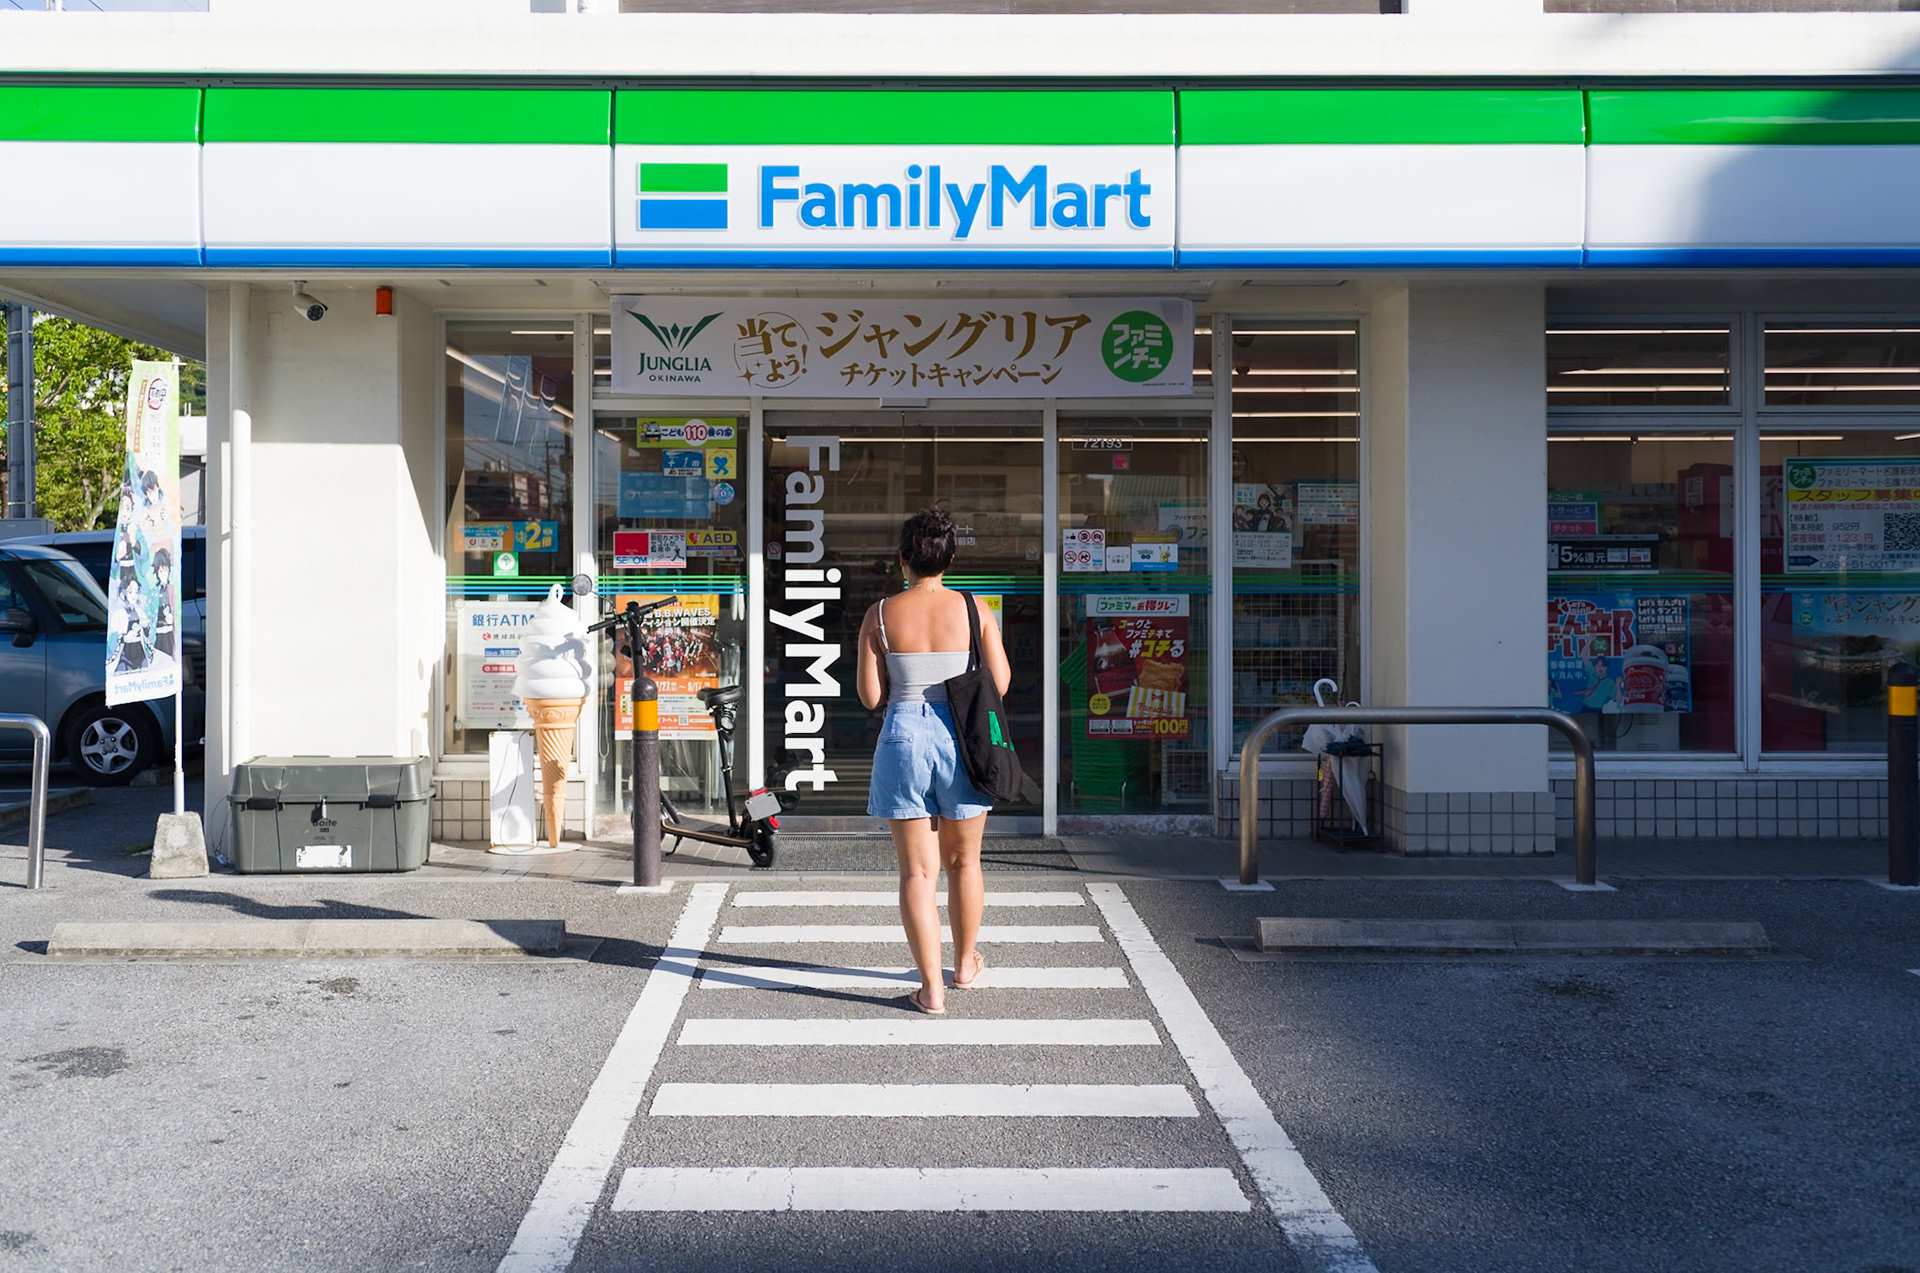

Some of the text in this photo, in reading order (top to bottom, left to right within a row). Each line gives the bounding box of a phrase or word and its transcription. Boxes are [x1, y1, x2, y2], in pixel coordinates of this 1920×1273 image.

[759, 163, 1151, 240] FamilyMart
[737, 318, 798, 357] 当て
[815, 308, 1092, 361] ジャングリア
[1112, 323, 1163, 347] ファミ
[637, 352, 712, 376] JUNGLIA
[1113, 346, 1162, 369] ンチュ
[649, 374, 702, 383] OKINAWA
[840, 362, 1064, 388] チケットキャンペーン
[703, 533, 733, 544] AED
[616, 556, 648, 564] SECOM
[1560, 546, 1606, 563] 5%還元
[655, 608, 711, 618] B.B.WAVES
[769, 435, 841, 791] FamilyMart
[1118, 620, 1152, 629] コークと
[1125, 629, 1173, 638] ファミチキで
[1152, 719, 1188, 734] 100円
